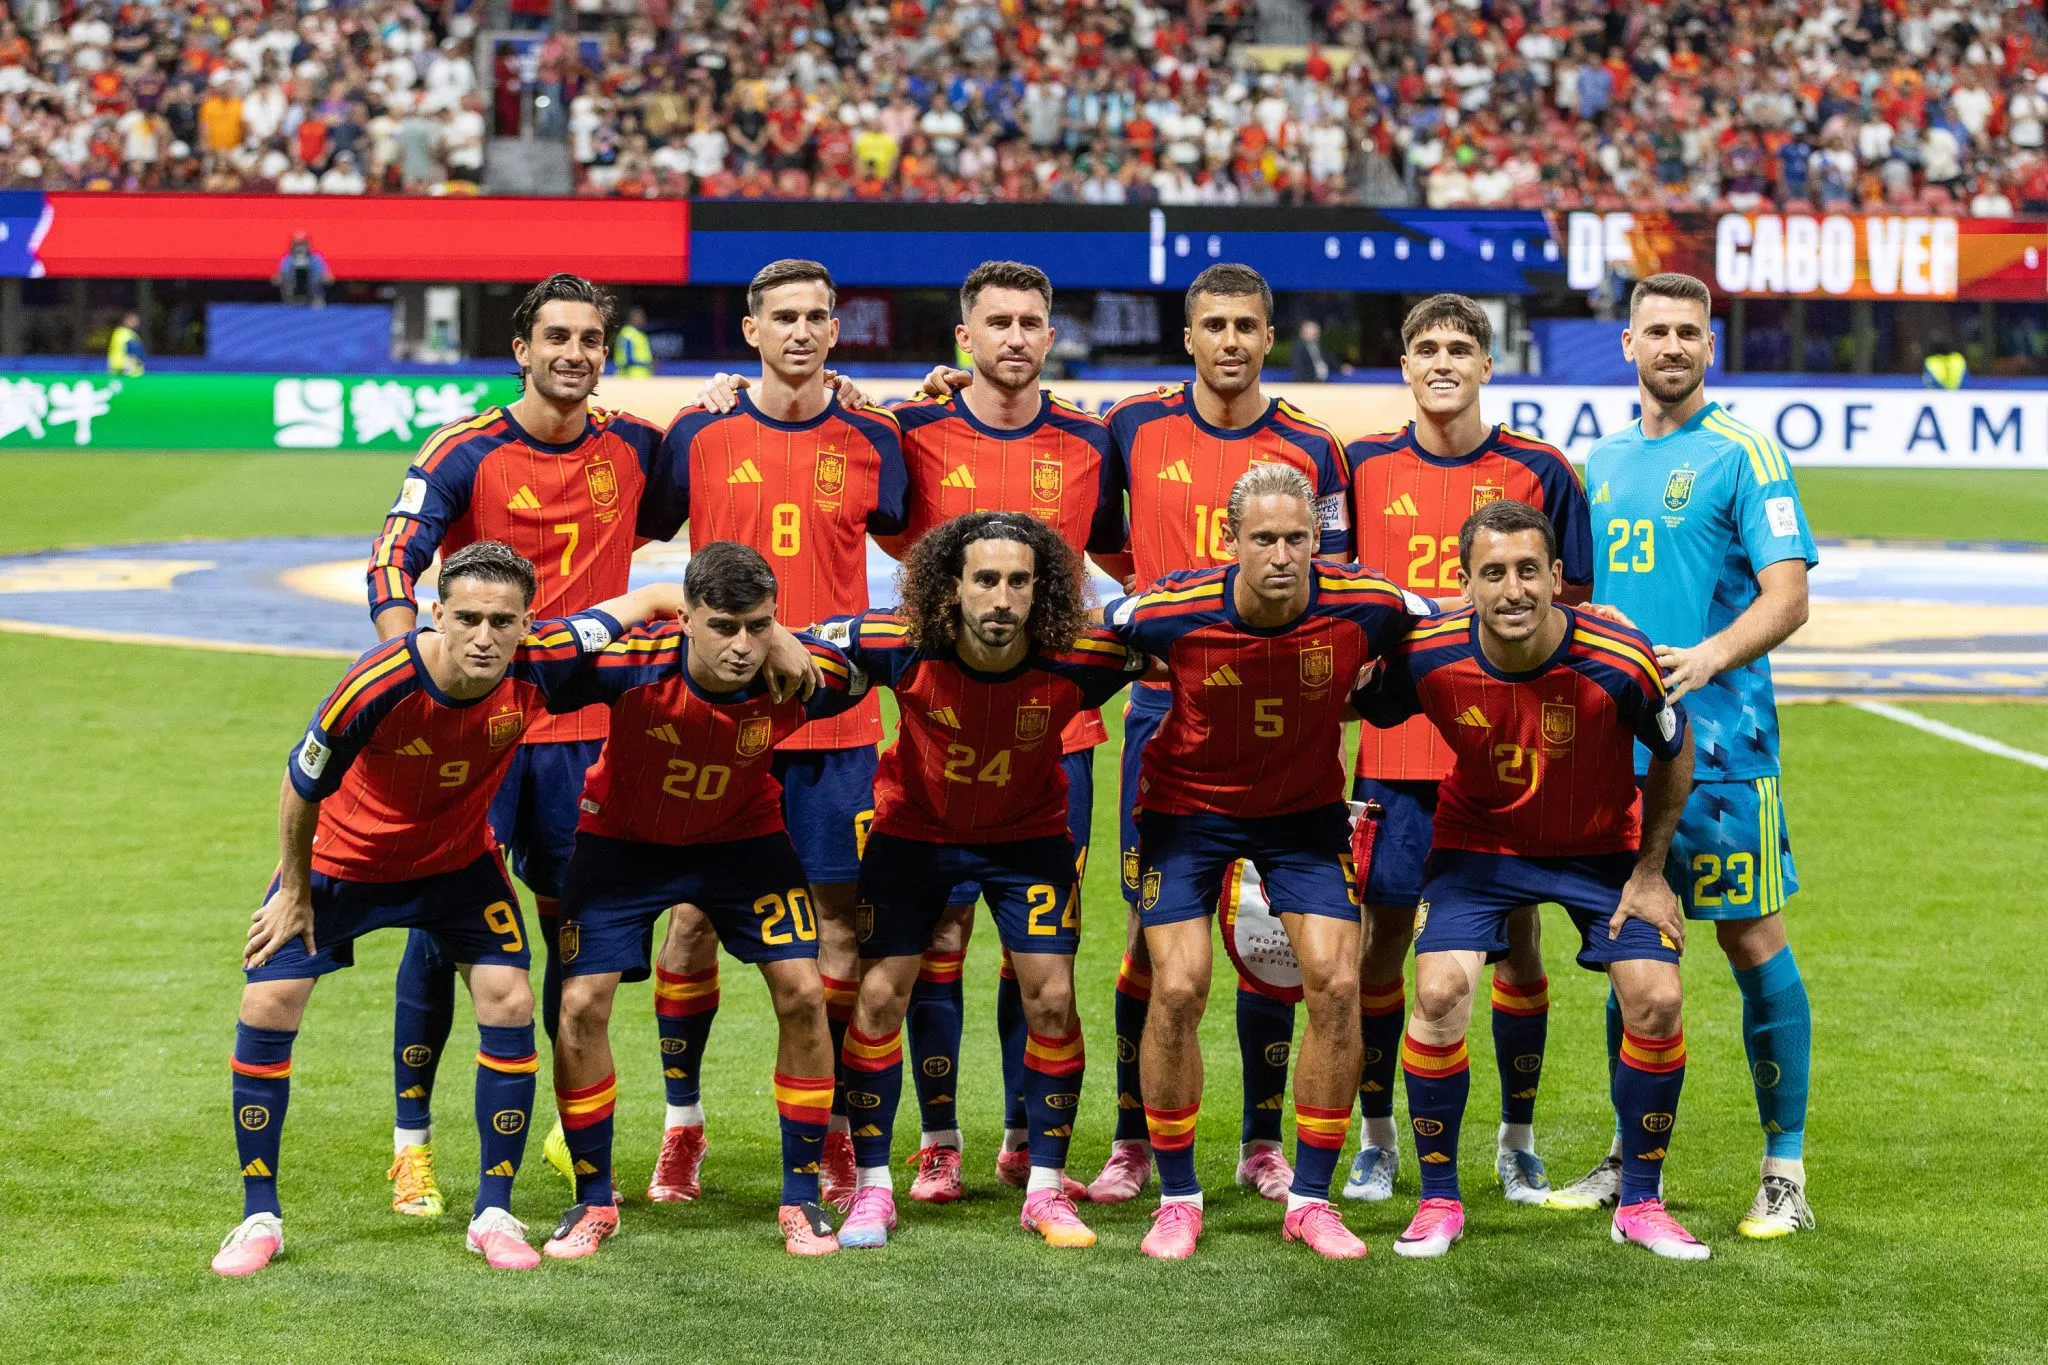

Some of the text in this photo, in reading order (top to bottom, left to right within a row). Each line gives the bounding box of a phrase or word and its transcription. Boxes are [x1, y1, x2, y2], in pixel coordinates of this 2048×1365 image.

[1716, 213, 1855, 293] CABO
[1511, 401, 2048, 452] BA OF AM
[553, 522, 579, 576] 7
[771, 503, 801, 557] 8
[1607, 518, 1655, 573] 23
[1407, 534, 1462, 589] 22
[1253, 698, 1284, 738] 5
[438, 760, 470, 788] 9
[662, 759, 731, 801] 20
[943, 743, 1012, 787] 24
[1494, 743, 1539, 793] 21
[1692, 851, 1754, 907] 23
[483, 900, 524, 953] 9
[752, 887, 817, 946] 20
[1026, 882, 1081, 937] 24
[1248, 936, 1292, 948] FEDERA
[1270, 959, 1298, 969] FÚTB
[245, 1117, 263, 1125] EF
